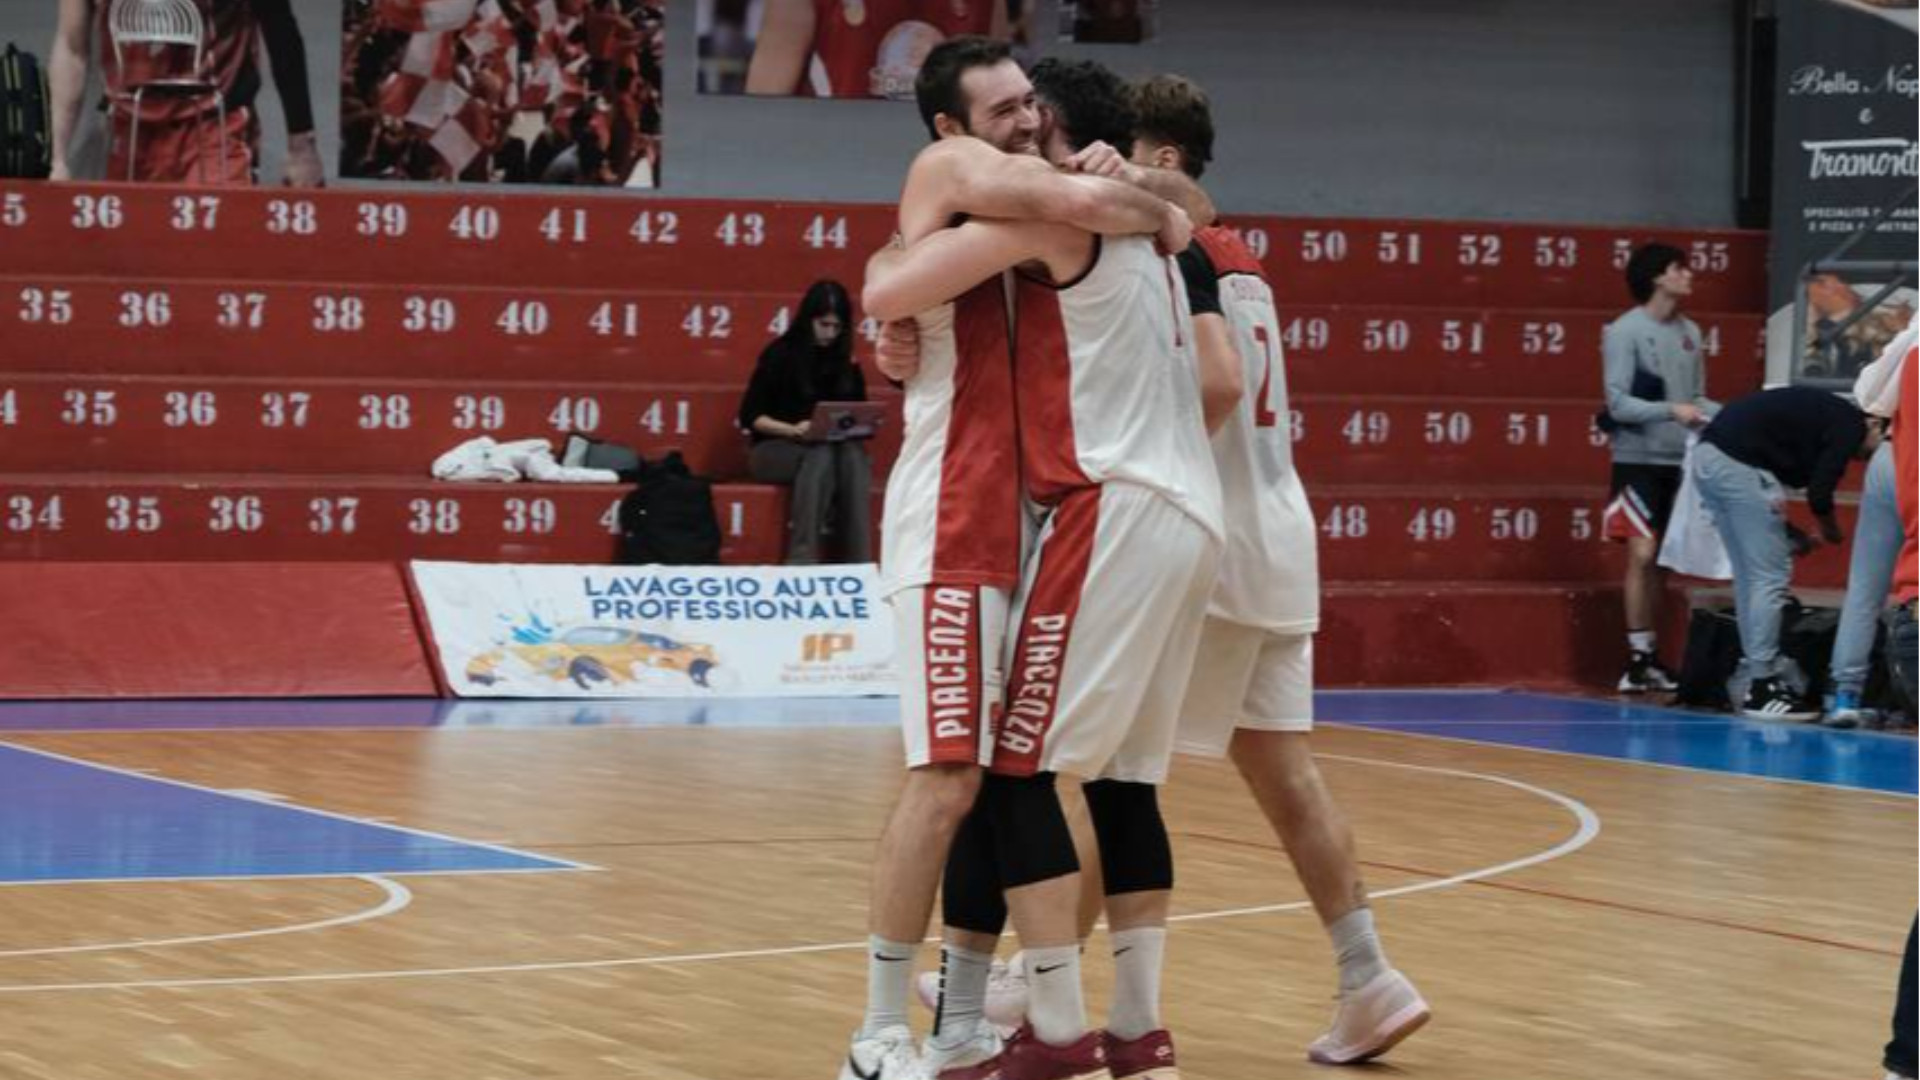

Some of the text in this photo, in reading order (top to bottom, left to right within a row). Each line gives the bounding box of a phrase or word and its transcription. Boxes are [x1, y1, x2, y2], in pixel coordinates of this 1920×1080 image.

[1788, 65, 1860, 95] Bella
[71, 195, 123, 229] 36
[171, 196, 220, 230] 37
[266, 200, 317, 235] 38
[357, 203, 407, 236] 39
[448, 206, 500, 240] 40
[539, 208, 586, 242] 41
[629, 211, 679, 243] 42
[716, 213, 765, 246] 43
[803, 215, 848, 249] 44
[1243, 229, 1268, 259] 9
[1301, 230, 1347, 260] 50
[1378, 231, 1420, 264] 51
[1459, 235, 1500, 265] 52
[1535, 237, 1577, 267] 53
[1613, 239, 1631, 268] 5
[1690, 241, 1729, 271] 55
[20, 288, 73, 324] 35
[119, 291, 172, 327] 36
[217, 293, 267, 328] 37
[313, 296, 364, 331] 38
[402, 297, 456, 332] 39
[496, 300, 549, 335] 40
[589, 302, 637, 336] 41
[681, 305, 731, 338] 42
[767, 306, 790, 336] 4
[1284, 318, 1329, 349] 49
[1363, 320, 1410, 351] 50
[1441, 320, 1483, 353] 51
[1522, 323, 1565, 353] 52
[1701, 326, 1720, 357] 4
[62, 390, 117, 425] 35
[163, 391, 217, 427] 36
[261, 392, 311, 428] 37
[358, 394, 411, 430] 38
[452, 396, 505, 430] 39
[548, 397, 600, 432] 40
[640, 400, 689, 434] 41
[1342, 410, 1390, 444] 49
[1425, 412, 1472, 444] 50
[1507, 413, 1548, 445] 51
[8, 496, 63, 531] 34
[106, 496, 161, 531] 35
[209, 496, 263, 531] 36
[309, 497, 359, 533] 37
[408, 499, 460, 534] 38
[503, 498, 556, 534] 39
[599, 499, 622, 535] 4
[730, 502, 743, 536] 1
[1321, 505, 1368, 538] 48
[1407, 508, 1455, 541] 49
[1490, 508, 1538, 540] 50
[584, 576, 863, 597] LAVAGGIO AUTO
[592, 598, 870, 620] PROFESSIONALE
[801, 632, 855, 663] IP
[928, 587, 972, 739] PIACENZA
[1000, 613, 1068, 755] PIACENZA
